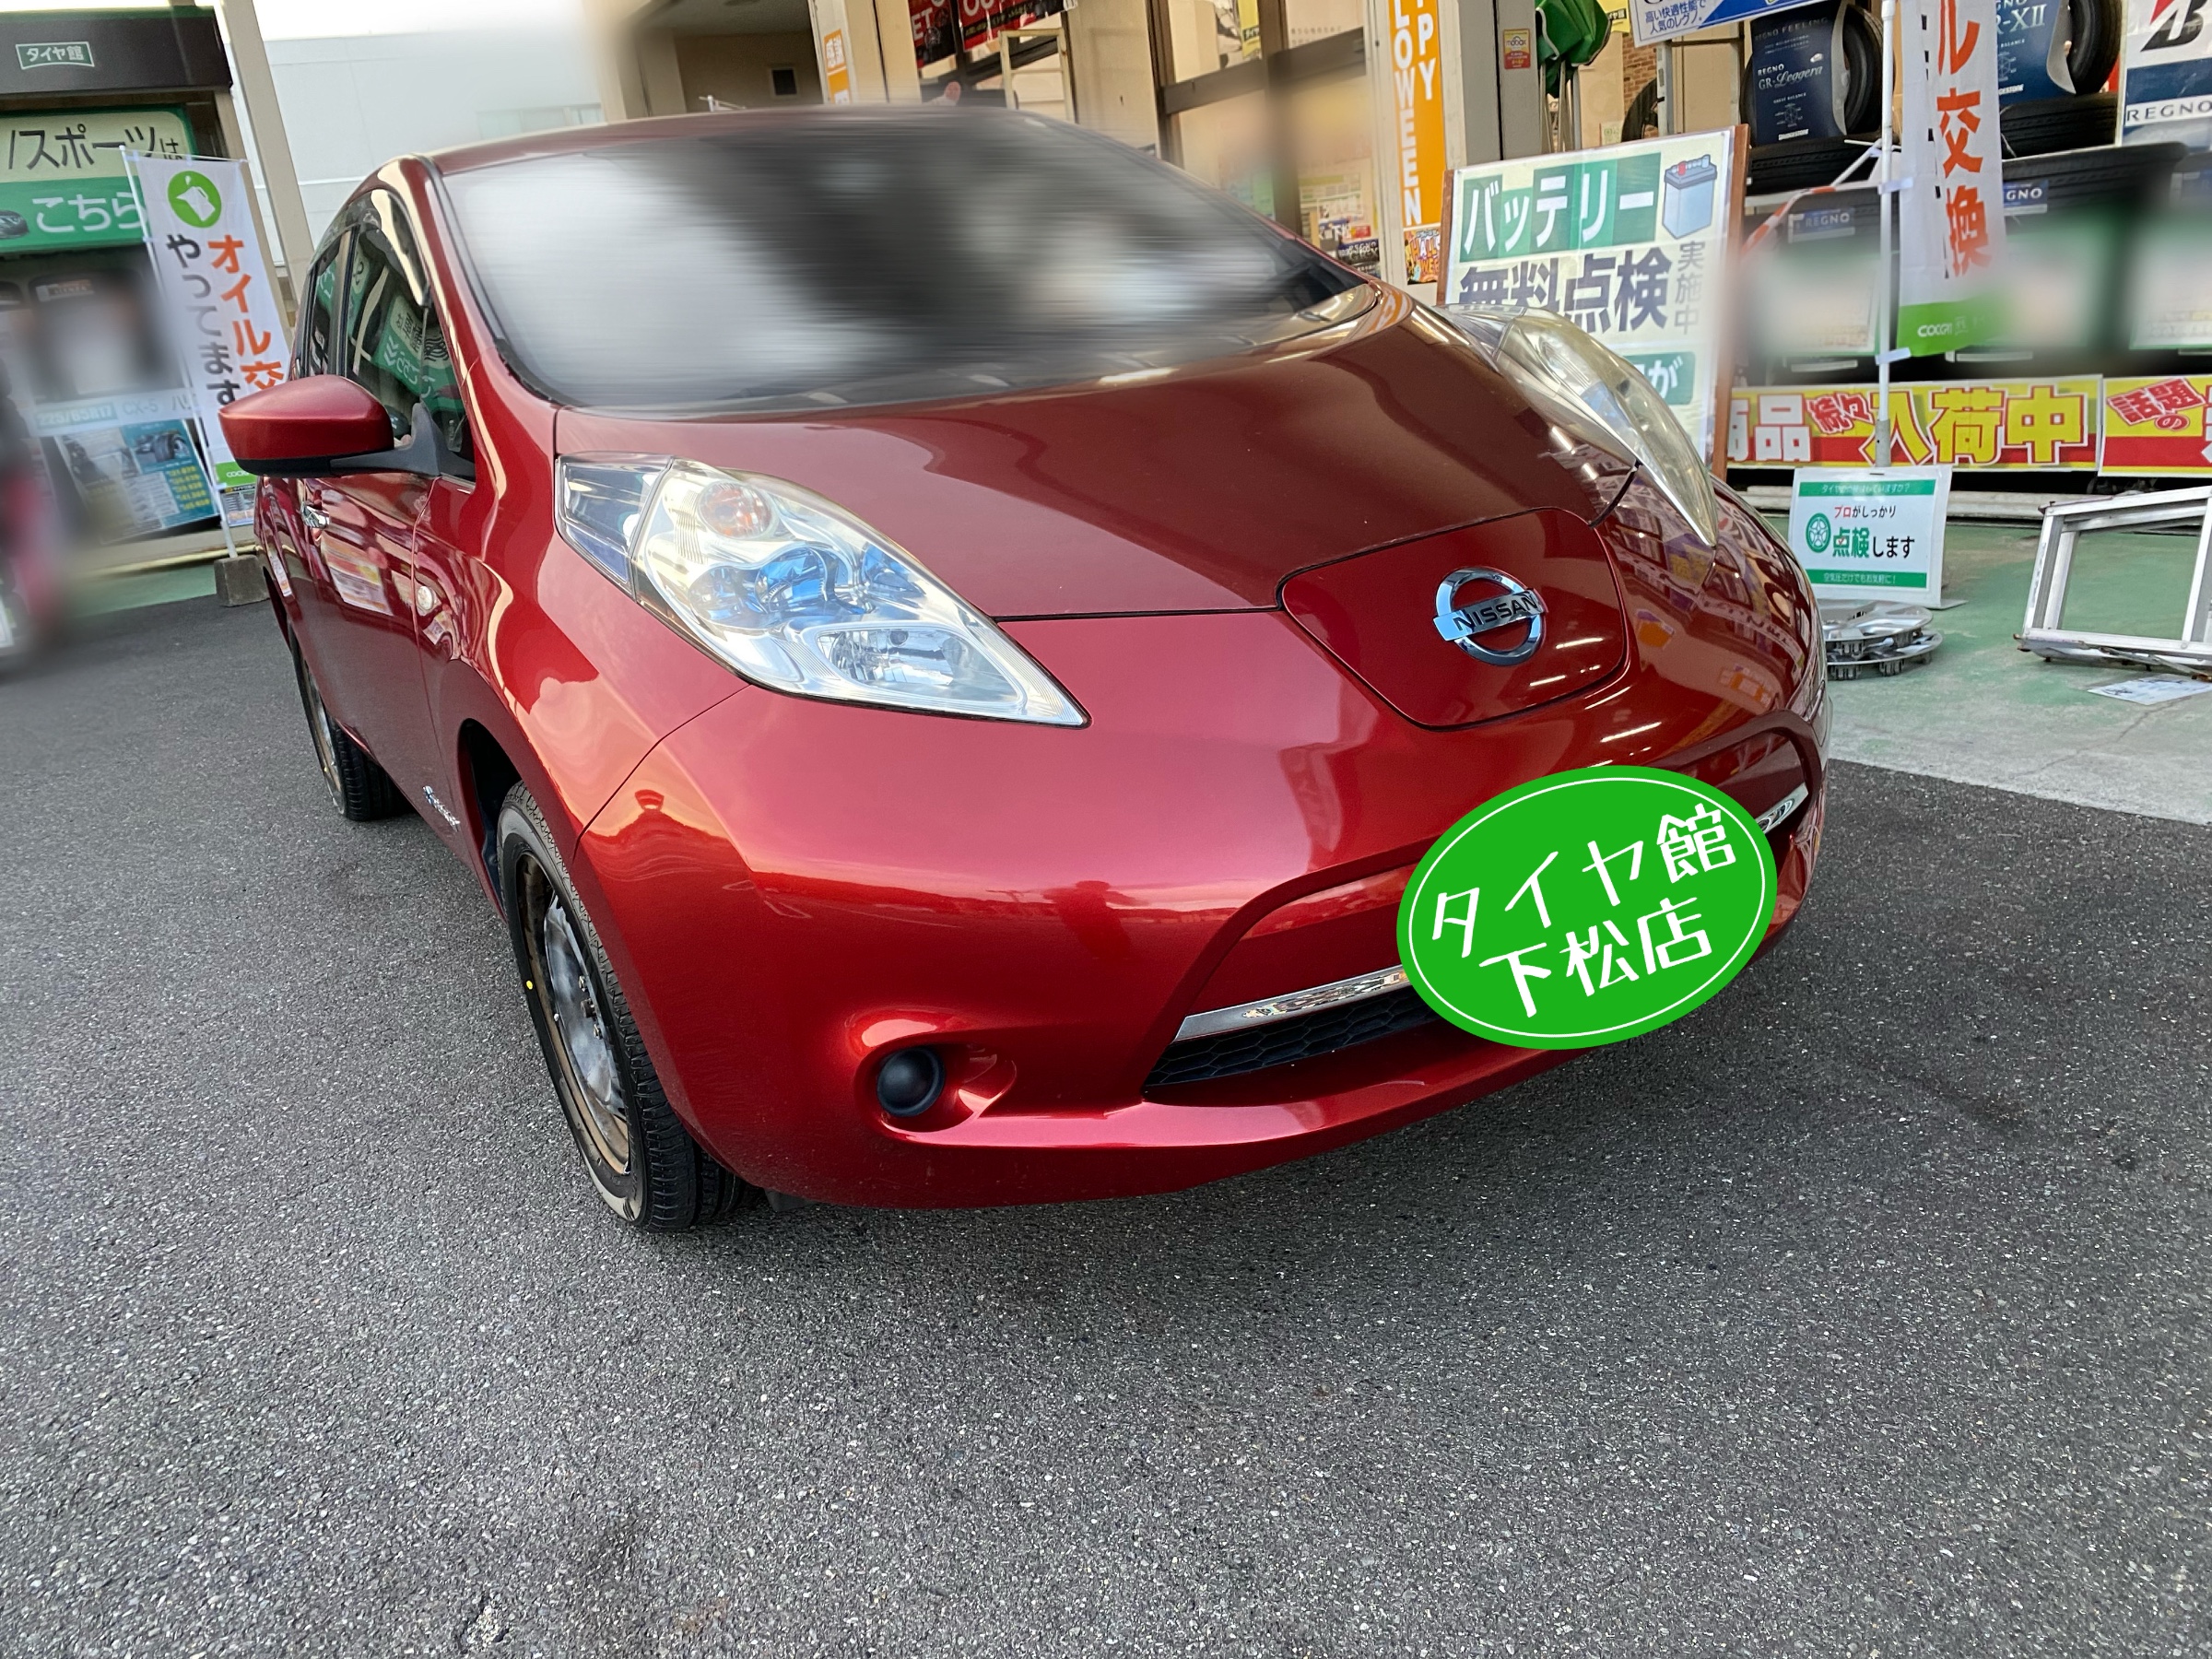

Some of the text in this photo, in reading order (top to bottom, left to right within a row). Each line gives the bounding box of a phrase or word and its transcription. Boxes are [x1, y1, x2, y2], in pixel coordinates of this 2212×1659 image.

[27, 45, 84, 62] タイヤ館
[1757, 63, 1784, 76] REGNO
[2126, 100, 2212, 122] REGNO
[32, 192, 147, 233] こちら
[1464, 169, 1654, 255] バッテリー
[1806, 212, 1850, 228] REGNO
[1459, 246, 1672, 335] 無料点検
[1674, 240, 1704, 335] 実施中
[166, 234, 241, 406] やってます
[122, 398, 159, 416] CX-5
[1834, 505, 1896, 519] プロがしっかり
[1832, 526, 1915, 559] 点検します
[1453, 593, 1538, 631] NISSAN
